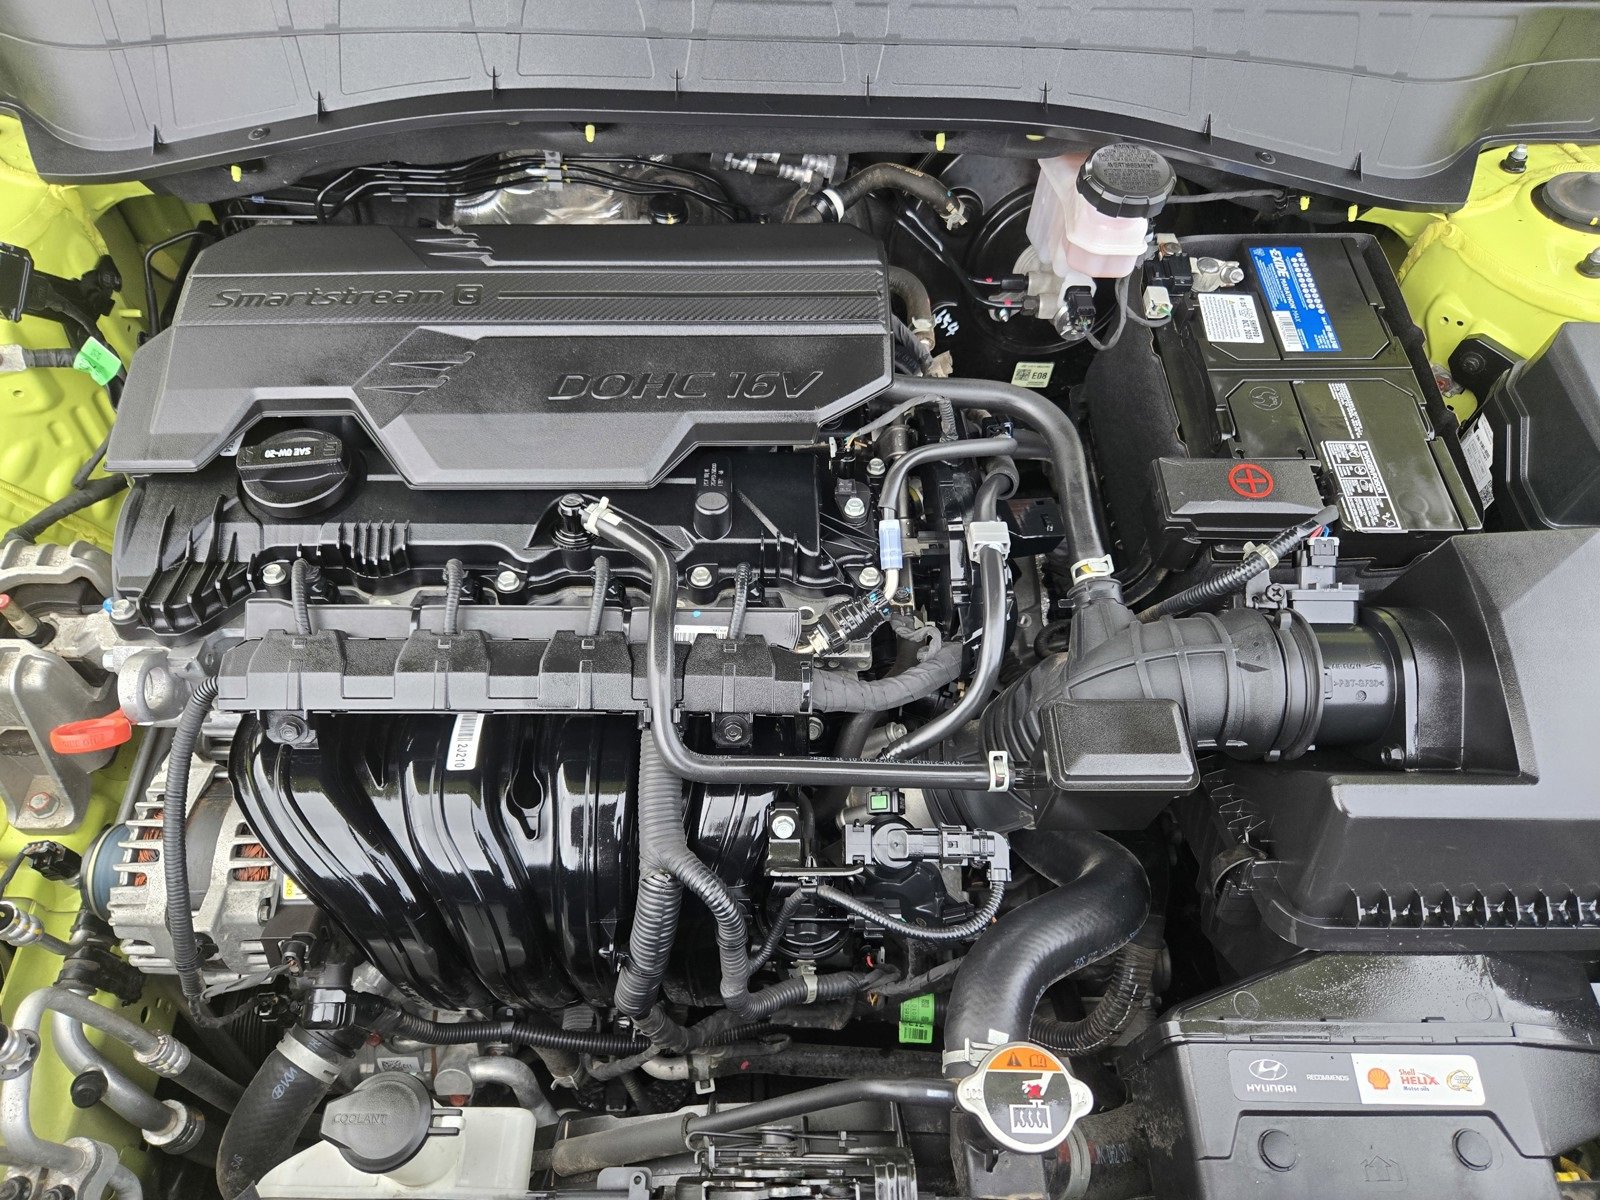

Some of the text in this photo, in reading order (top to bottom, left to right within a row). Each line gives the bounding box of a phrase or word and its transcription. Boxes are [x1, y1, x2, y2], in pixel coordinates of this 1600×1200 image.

[1269, 248, 1290, 280] EXIDE
[209, 286, 445, 308] Smartstream
[1032, 372, 1048, 380] E08
[548, 370, 824, 400] DOHC 16V
[264, 447, 312, 458] SAE 0W-20
[454, 743, 469, 768] 2J210
[1399, 1068, 1416, 1076] Shell
[1306, 1074, 1350, 1082] RECOMMENDS
[1400, 1076, 1438, 1085] HELIX
[1246, 1084, 1297, 1093] HYUNDAI
[332, 1113, 388, 1125] COOLANT
